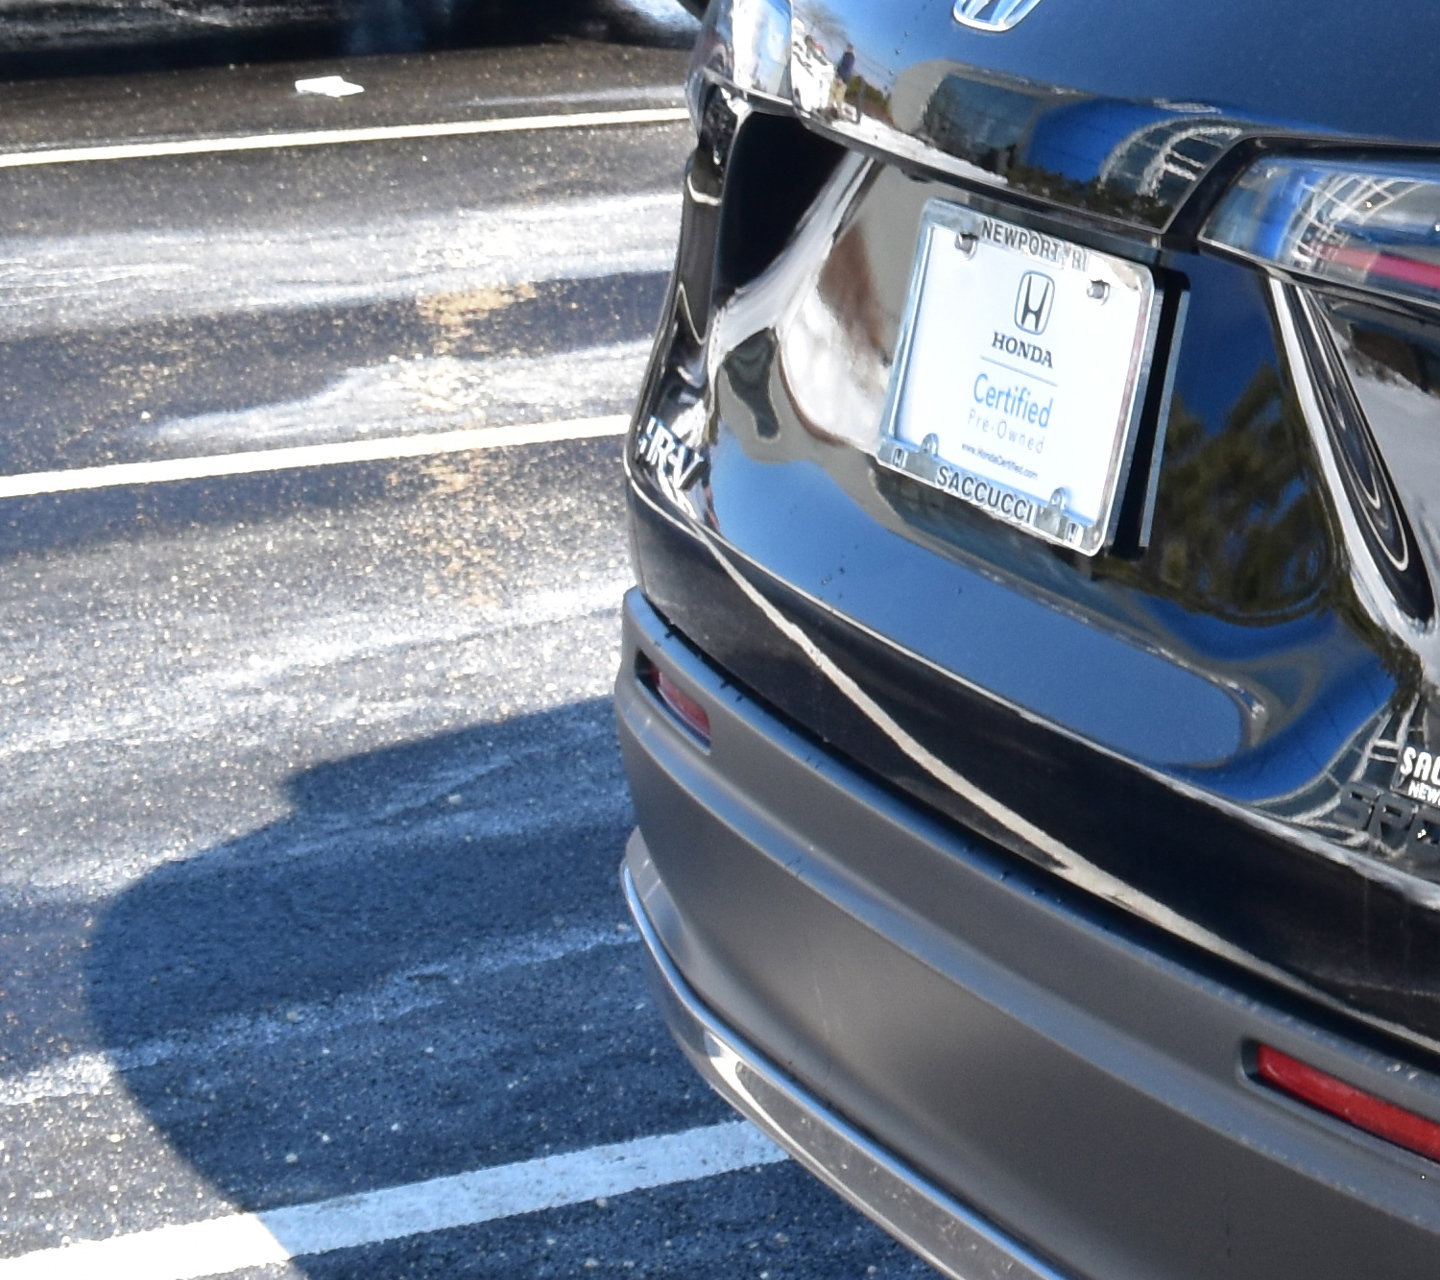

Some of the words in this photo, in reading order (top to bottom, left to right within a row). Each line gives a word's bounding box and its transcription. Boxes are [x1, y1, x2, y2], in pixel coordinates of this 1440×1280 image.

[992, 331, 1055, 369] HONDA
[973, 372, 1054, 428] Certified
[968, 407, 1046, 454] Pre-Owned
[936, 465, 1034, 521] SACCUCCI
